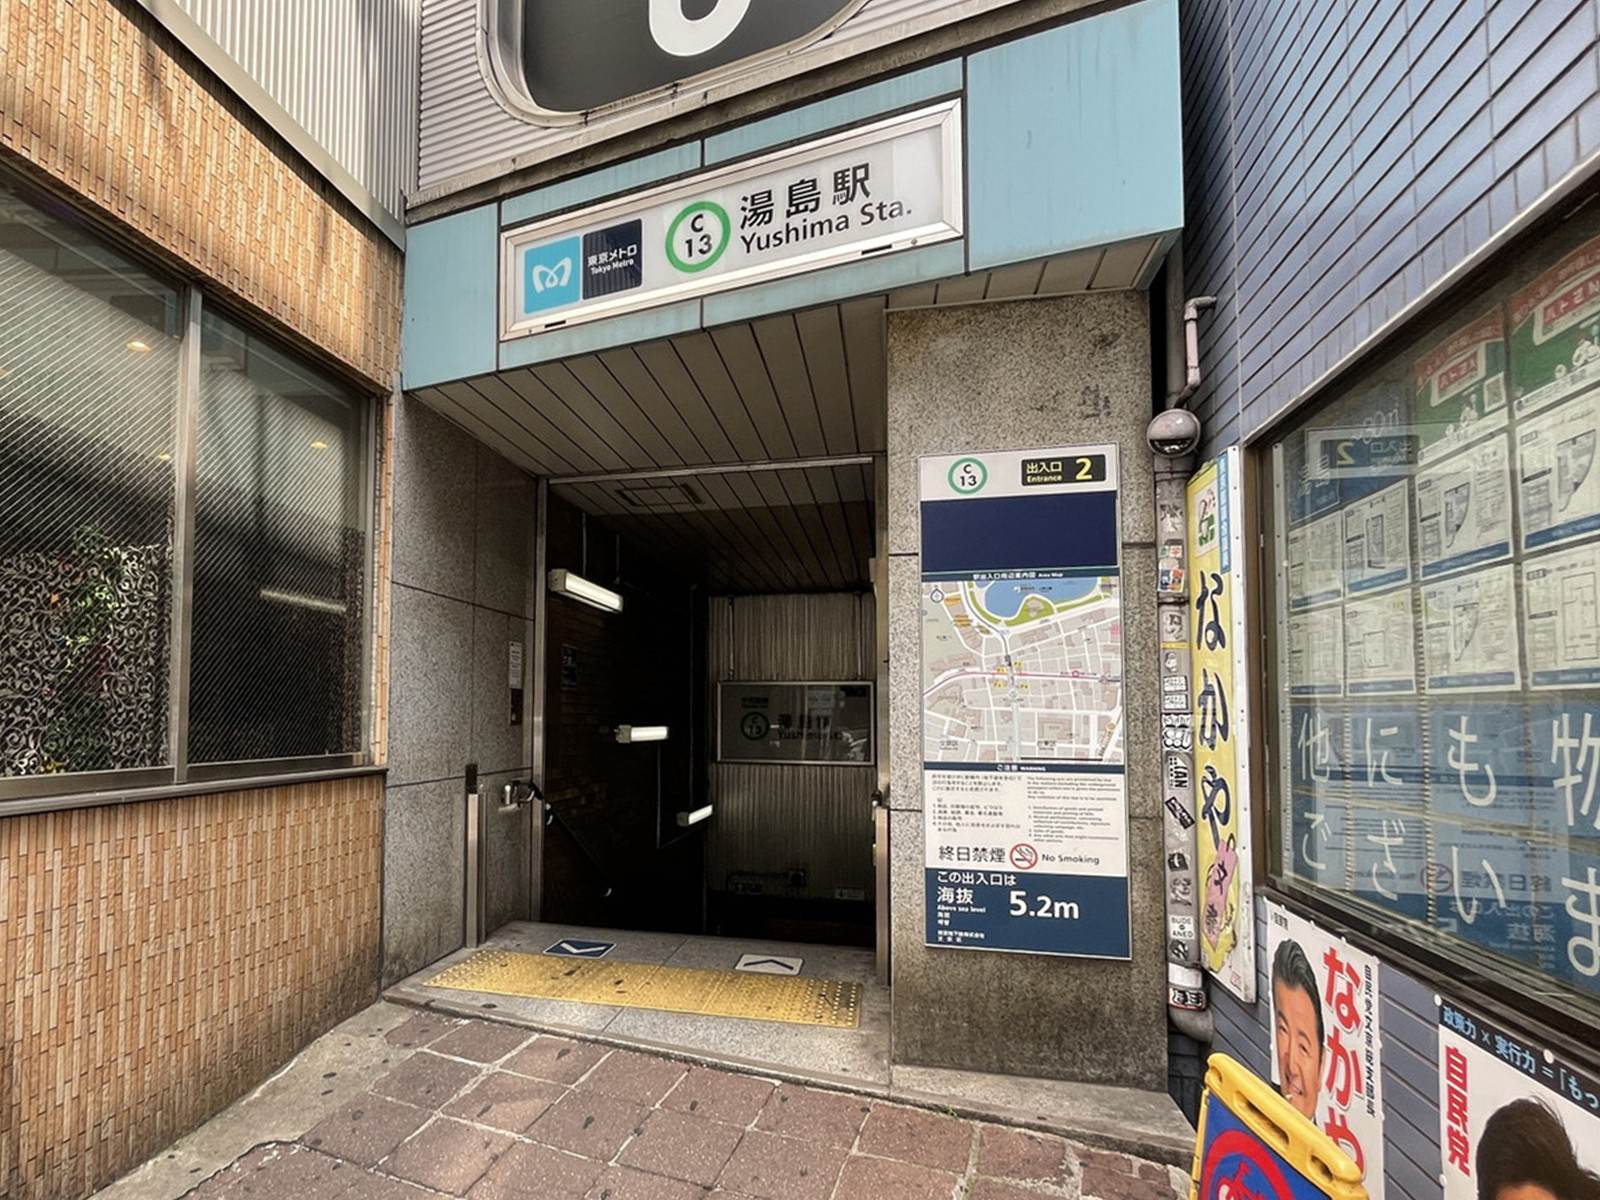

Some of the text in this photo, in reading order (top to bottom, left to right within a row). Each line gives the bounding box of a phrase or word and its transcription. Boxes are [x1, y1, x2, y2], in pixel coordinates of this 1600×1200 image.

[740, 163, 871, 230] 湯島駅
[691, 213, 704, 233] C
[740, 198, 913, 254] Yushima Sta.
[587, 244, 637, 268] 東京メトロ
[685, 234, 713, 258] 13
[959, 475, 978, 487] 13
[963, 463, 972, 475] C
[1026, 457, 1093, 481] 出入口 2
[1026, 474, 1063, 483] Entrance
[938, 845, 1101, 866] 終日禁煙 No Smoking
[937, 871, 1017, 887] この出入口は
[937, 886, 1080, 919] 海抜 5.2m
[1443, 1005, 1477, 1040] 政策力
[1494, 1034, 1536, 1074] 実行力
[1445, 1045, 1471, 1177] 自民党
